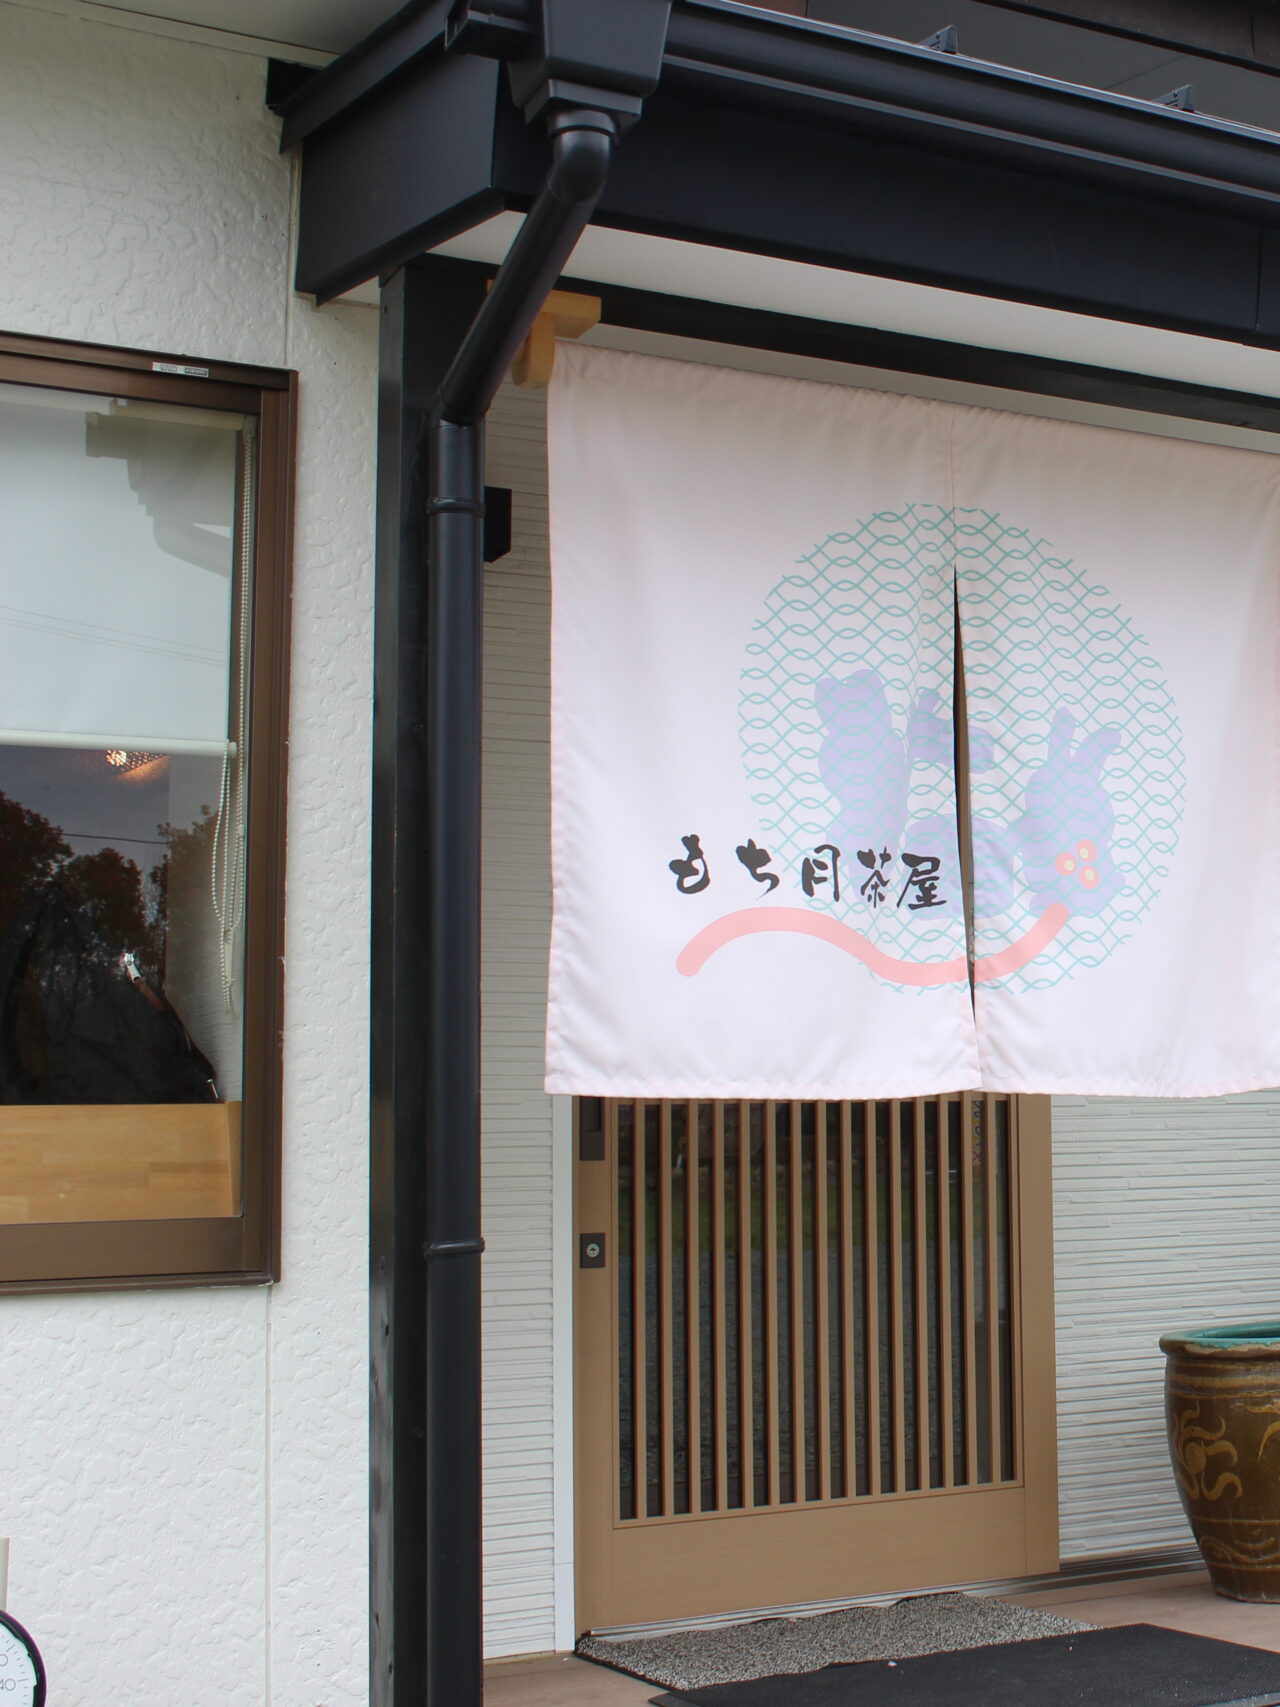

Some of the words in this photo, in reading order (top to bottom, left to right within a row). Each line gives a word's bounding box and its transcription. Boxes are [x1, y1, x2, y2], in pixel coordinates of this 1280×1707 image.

[668, 834, 947, 910] もち月茶屋
